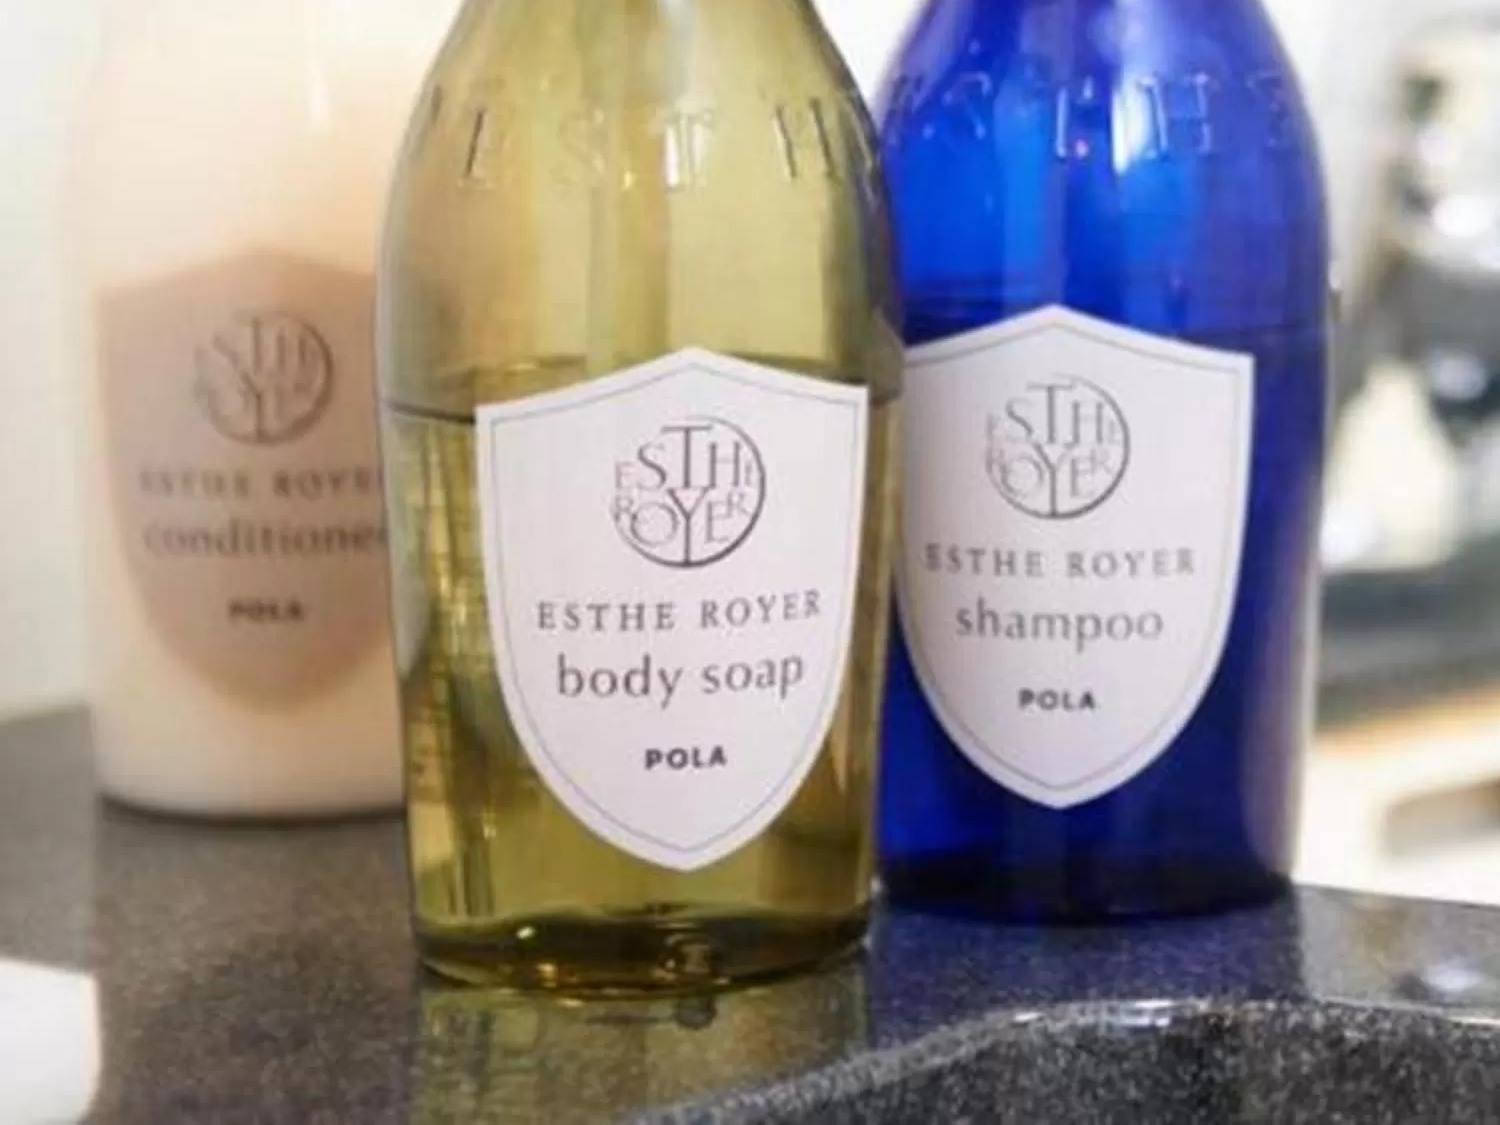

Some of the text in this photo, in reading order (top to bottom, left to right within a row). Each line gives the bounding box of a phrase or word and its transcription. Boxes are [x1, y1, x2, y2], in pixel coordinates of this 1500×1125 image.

[924, 542, 1197, 577] ESTHE ROYER
[537, 588, 822, 632] ESTHE ROYER
[955, 595, 1164, 654] shampoo
[556, 652, 804, 710] body soap
[1018, 687, 1097, 712] POLA
[643, 744, 728, 771] POLA
